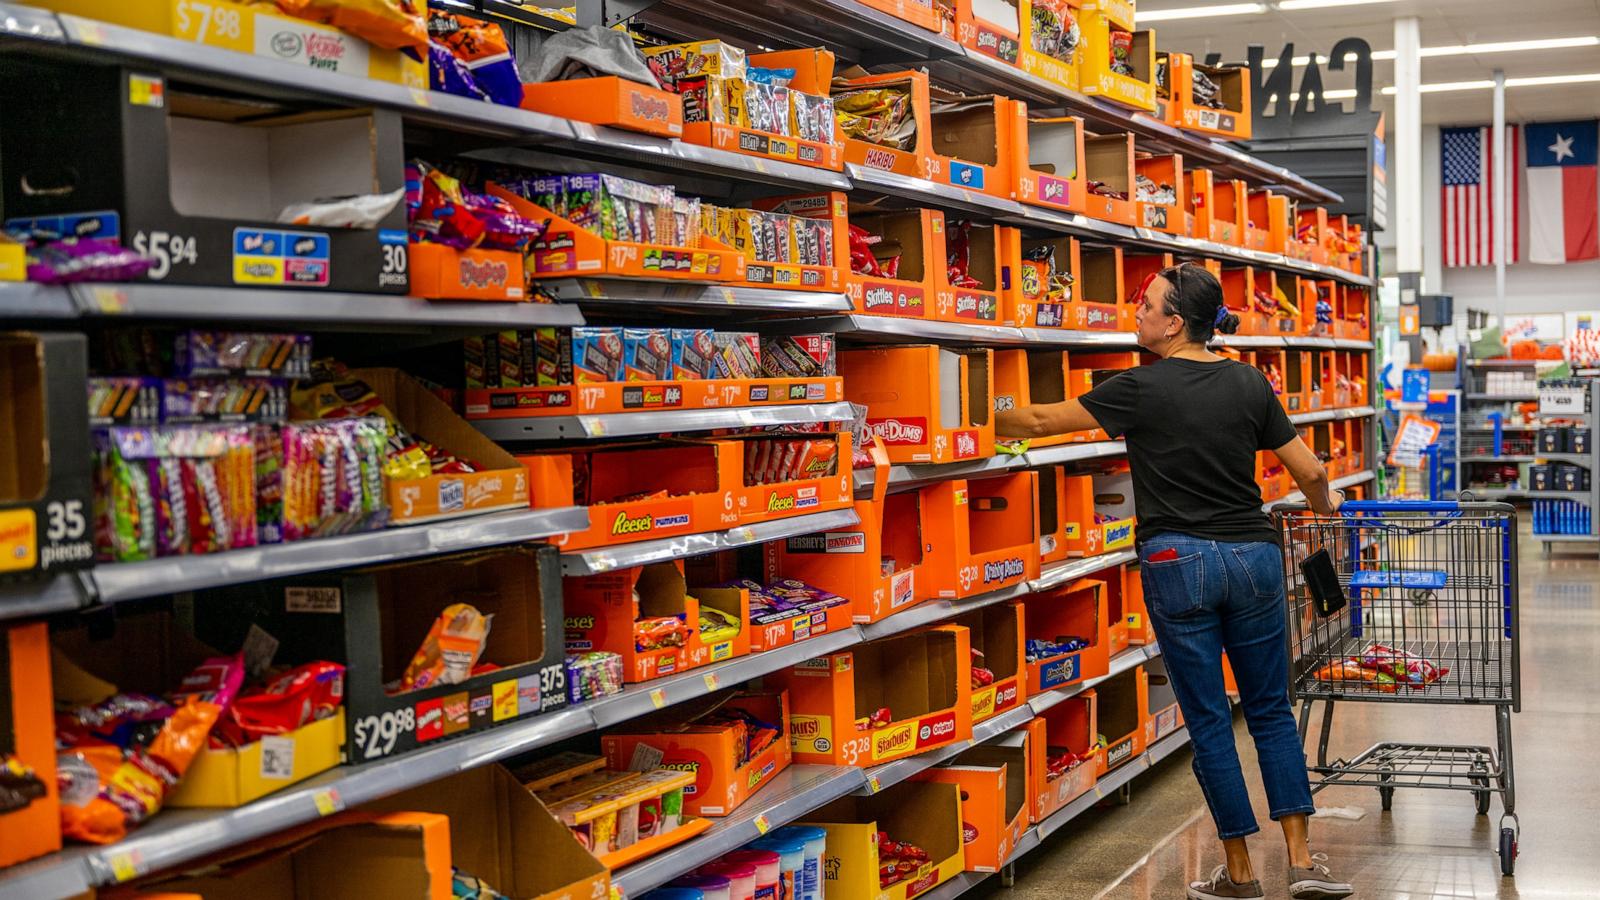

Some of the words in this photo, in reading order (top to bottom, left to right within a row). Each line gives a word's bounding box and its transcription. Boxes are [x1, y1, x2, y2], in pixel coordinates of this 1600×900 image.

[865, 149, 896, 171] HARIBO
[533, 180, 546, 192] 18
[570, 176, 583, 189] 18
[382, 245, 407, 272] 30
[866, 288, 893, 308] Skittles
[956, 295, 976, 313] Skittles
[807, 338, 819, 347] 18
[841, 475, 847, 492] 6
[724, 491, 733, 511] 6
[768, 491, 794, 513] Reese's
[46, 500, 86, 540] 35
[612, 510, 652, 536] Reese's
[720, 513, 738, 523] Packs
[788, 536, 825, 550] HERSHEY'S
[41, 541, 93, 570] pieces
[565, 616, 596, 630] ese's
[540, 664, 564, 693] 375
[541, 692, 566, 713] pieces
[354, 708, 416, 759] $2998
[790, 718, 818, 734] burst
[842, 736, 871, 766] $328
[876, 727, 913, 755] Starburst
